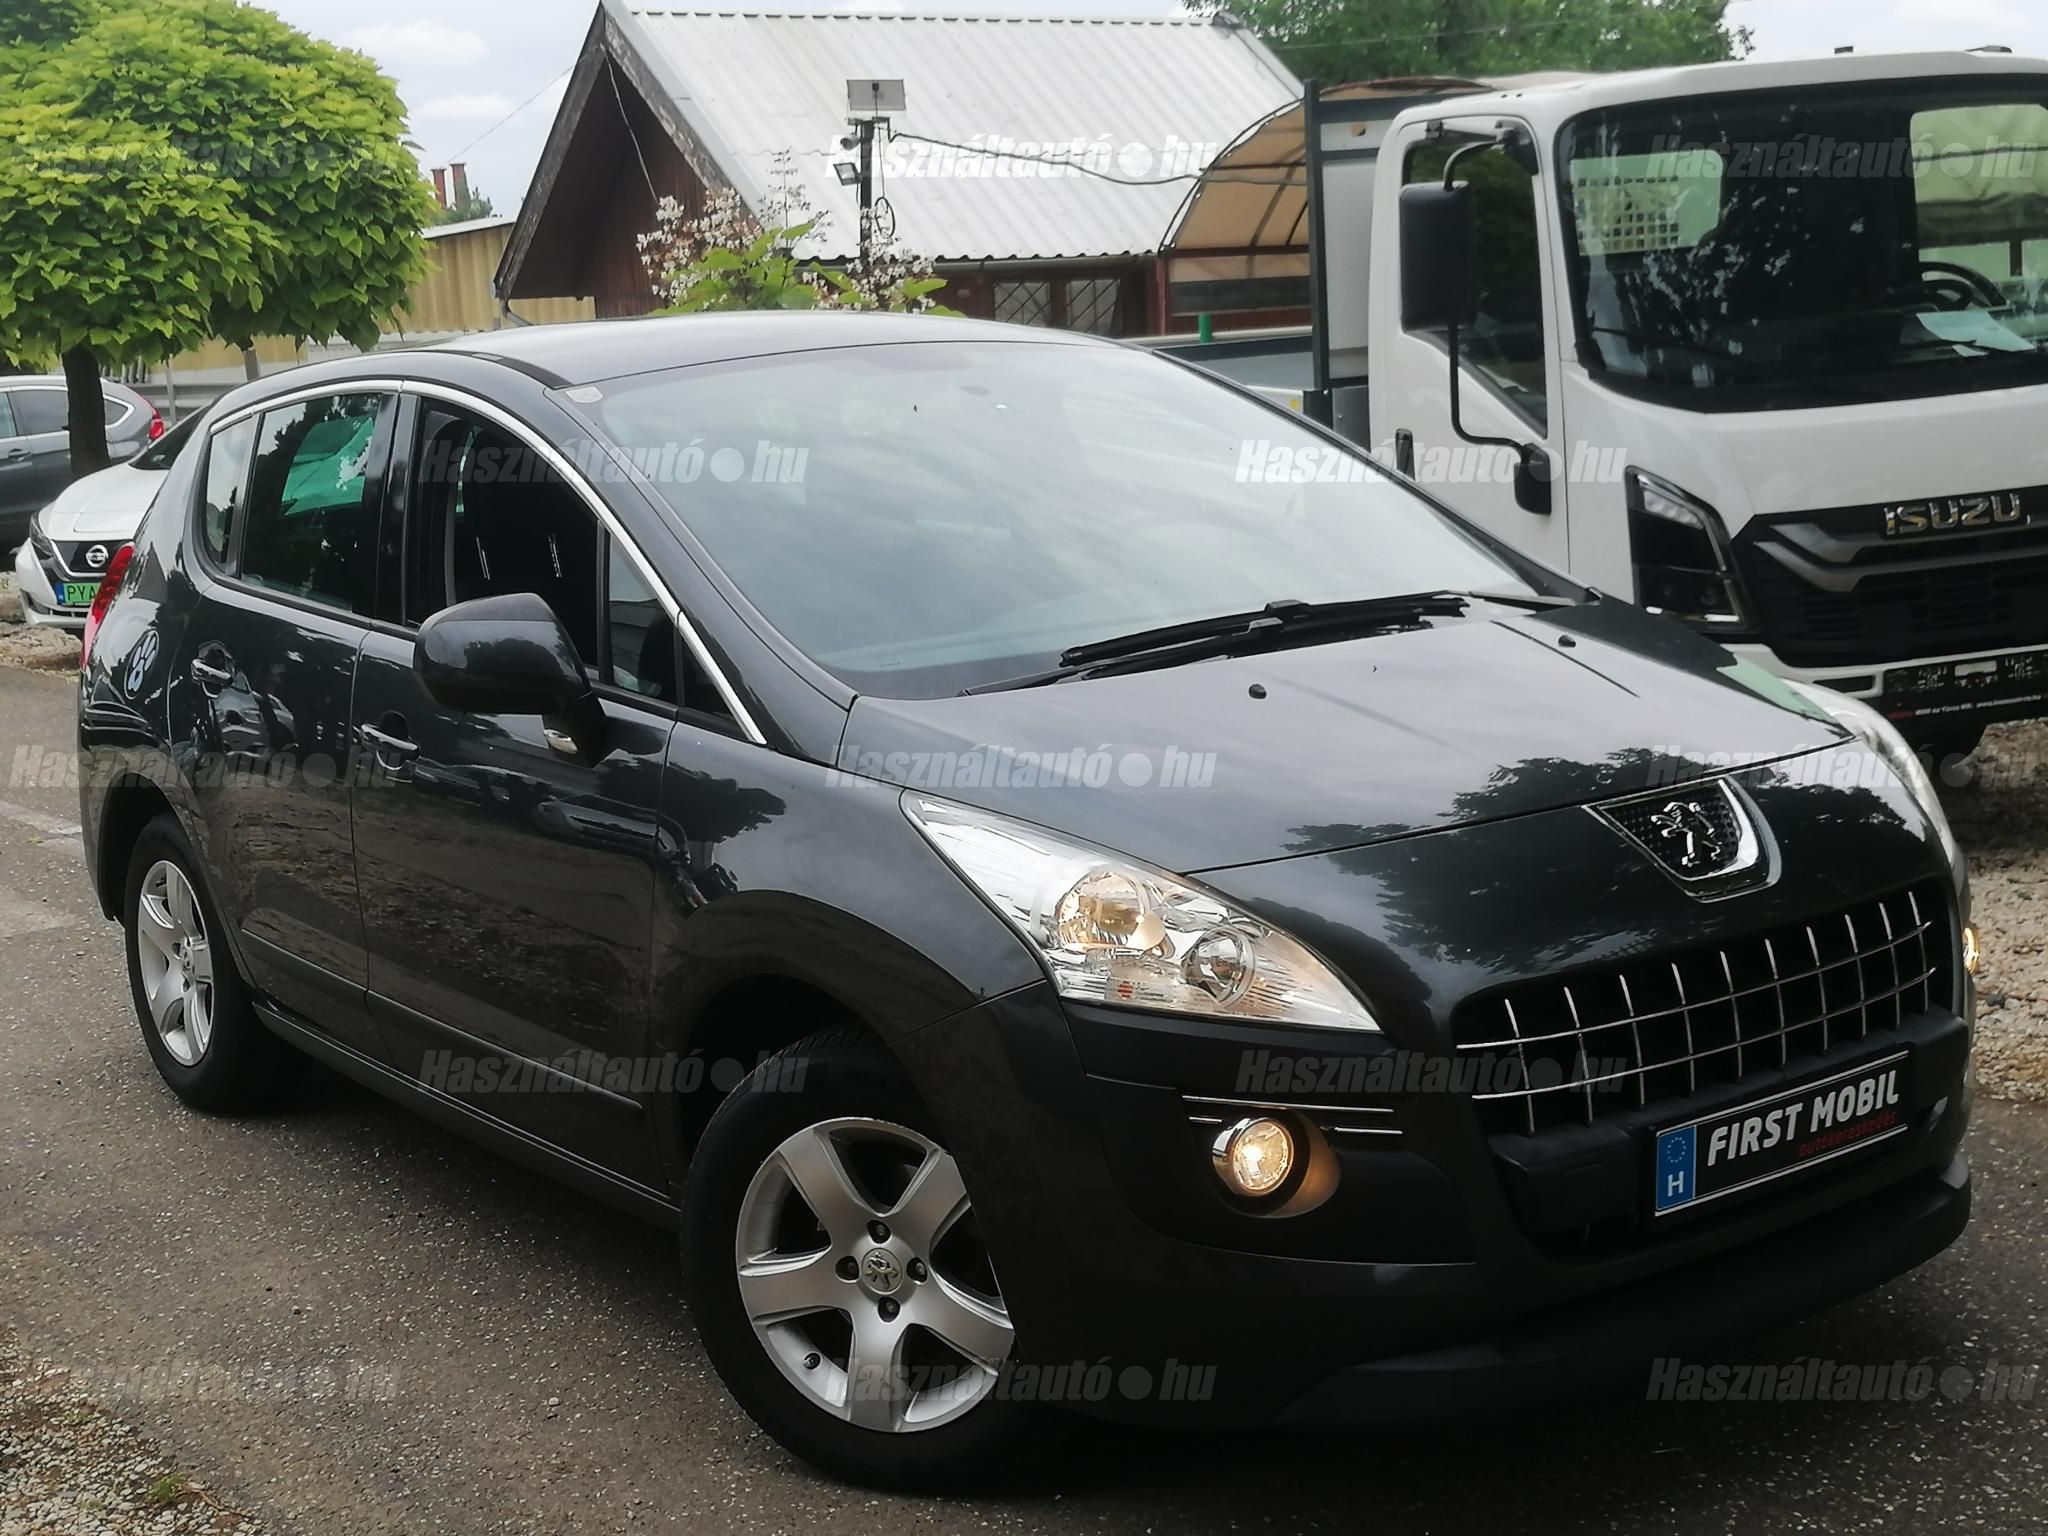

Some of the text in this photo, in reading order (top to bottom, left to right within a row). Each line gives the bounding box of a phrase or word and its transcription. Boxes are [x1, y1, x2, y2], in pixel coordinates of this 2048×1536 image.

[1884, 493, 2021, 535] ISUZU
[1707, 1070, 1899, 1167] FIRST MOBIL
[1667, 1171, 1685, 1197] H
